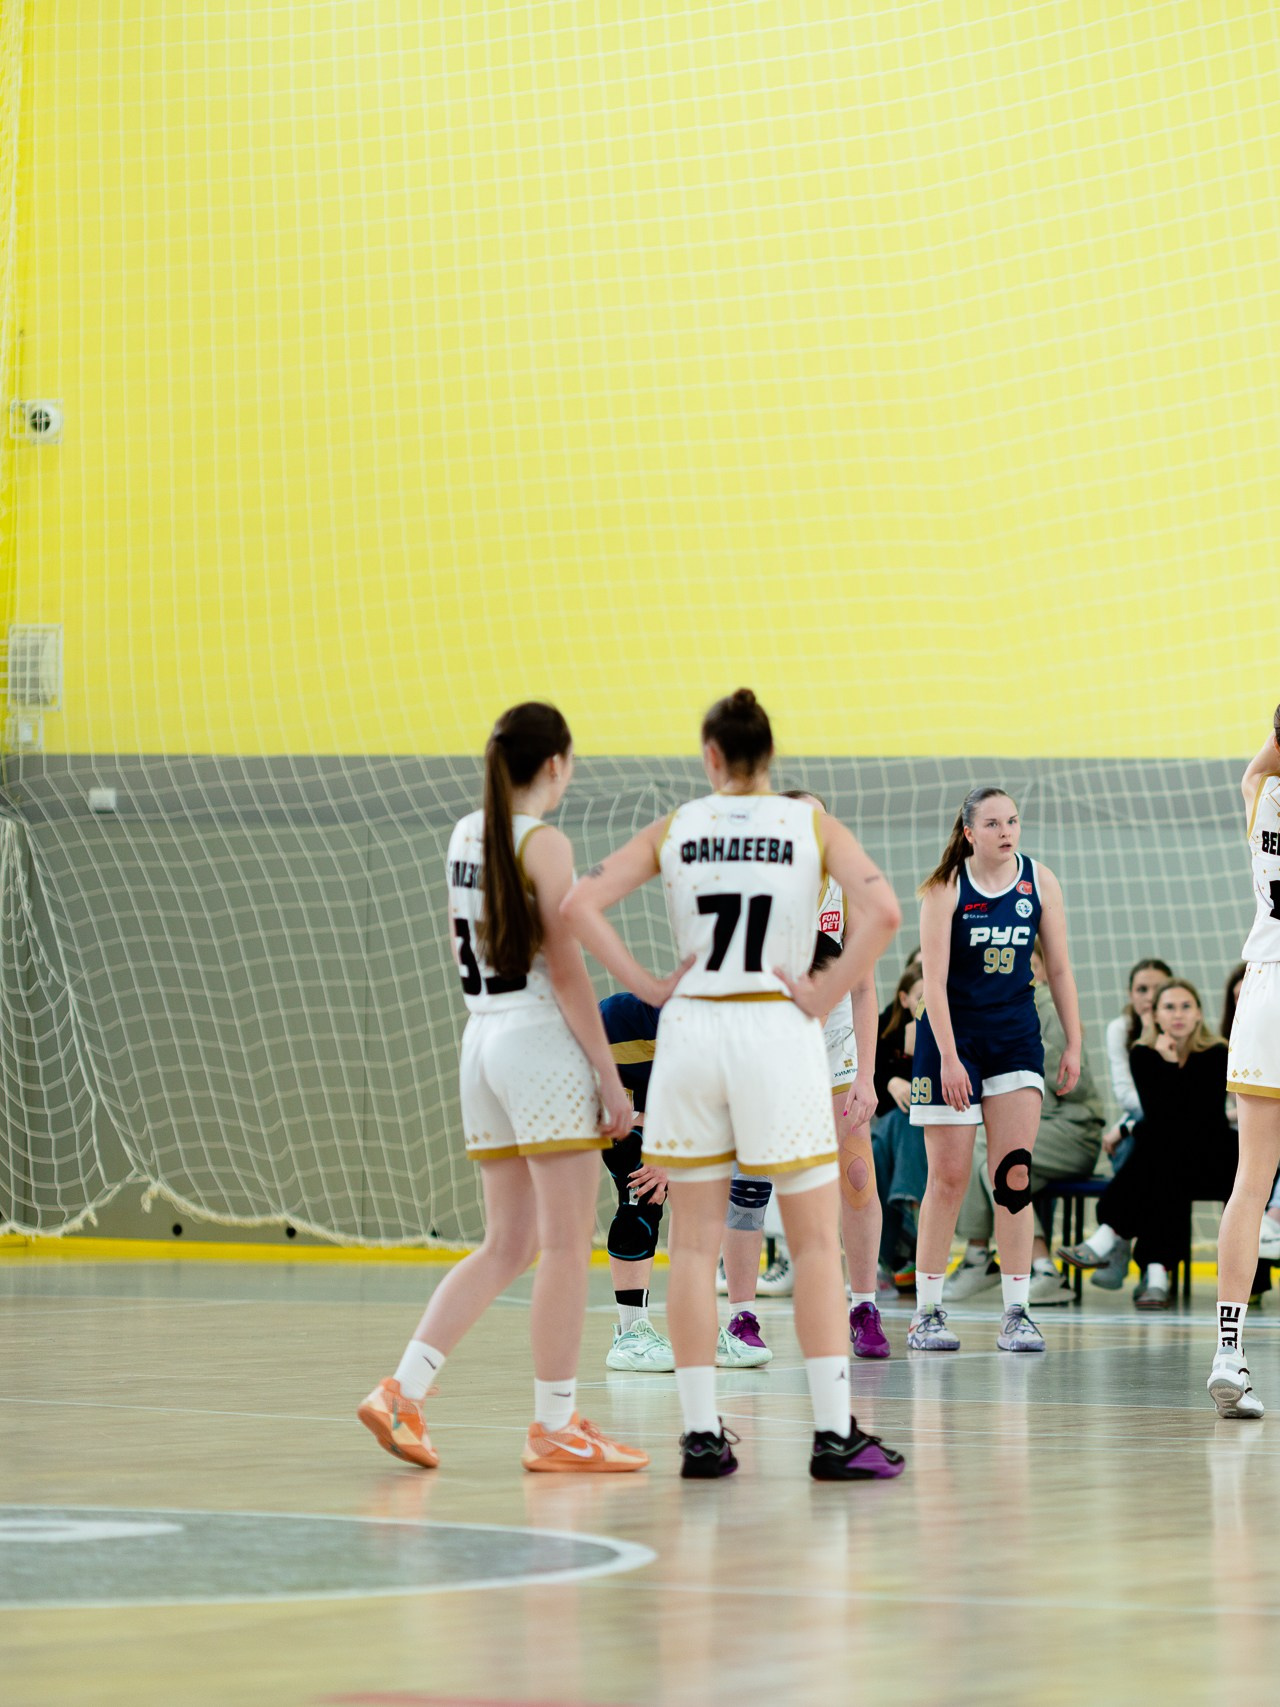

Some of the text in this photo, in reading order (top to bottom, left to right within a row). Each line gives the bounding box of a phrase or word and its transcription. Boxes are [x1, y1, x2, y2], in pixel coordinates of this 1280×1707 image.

[681, 837, 794, 866] ФАНДЕЕВА
[821, 913, 839, 923] FON
[821, 921, 840, 931] BET
[696, 893, 773, 972] 71
[970, 926, 1031, 947] РУС
[983, 947, 1016, 974] 99
[910, 1077, 932, 1104] 99
